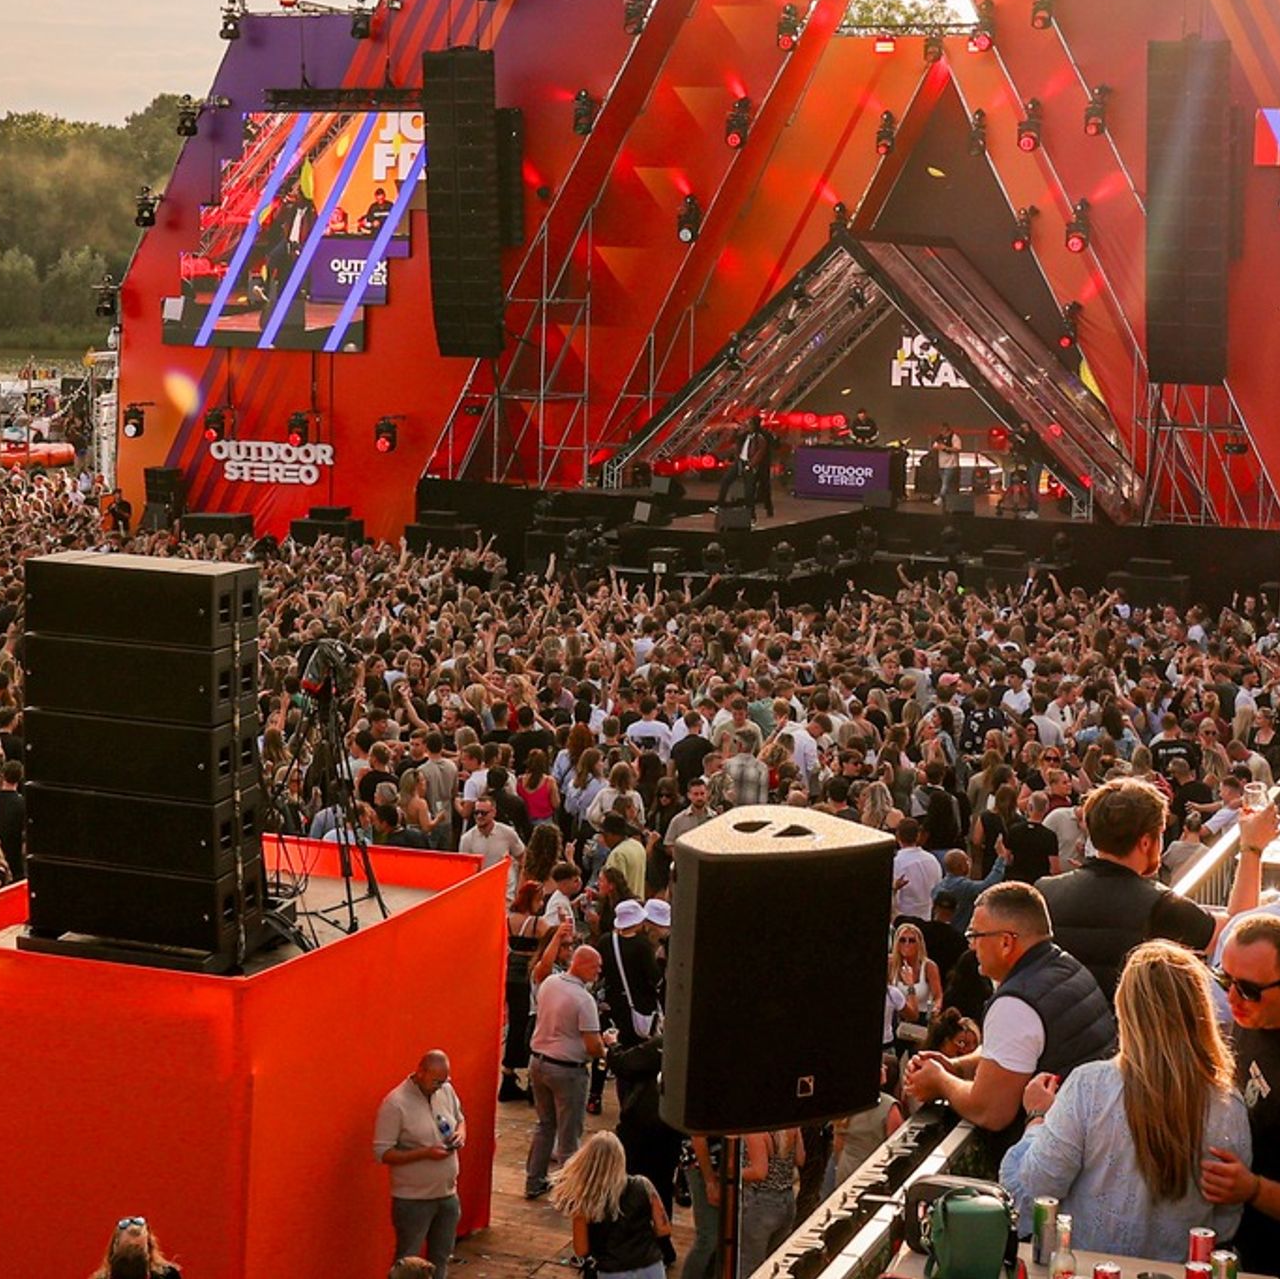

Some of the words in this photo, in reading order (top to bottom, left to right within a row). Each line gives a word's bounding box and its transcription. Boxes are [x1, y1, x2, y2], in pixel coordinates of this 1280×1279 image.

[210, 440, 334, 465] OUTDOOR
[224, 460, 320, 485] STEREO
[812, 464, 873, 478] OUTDOOR
[818, 476, 865, 487] STEREO
